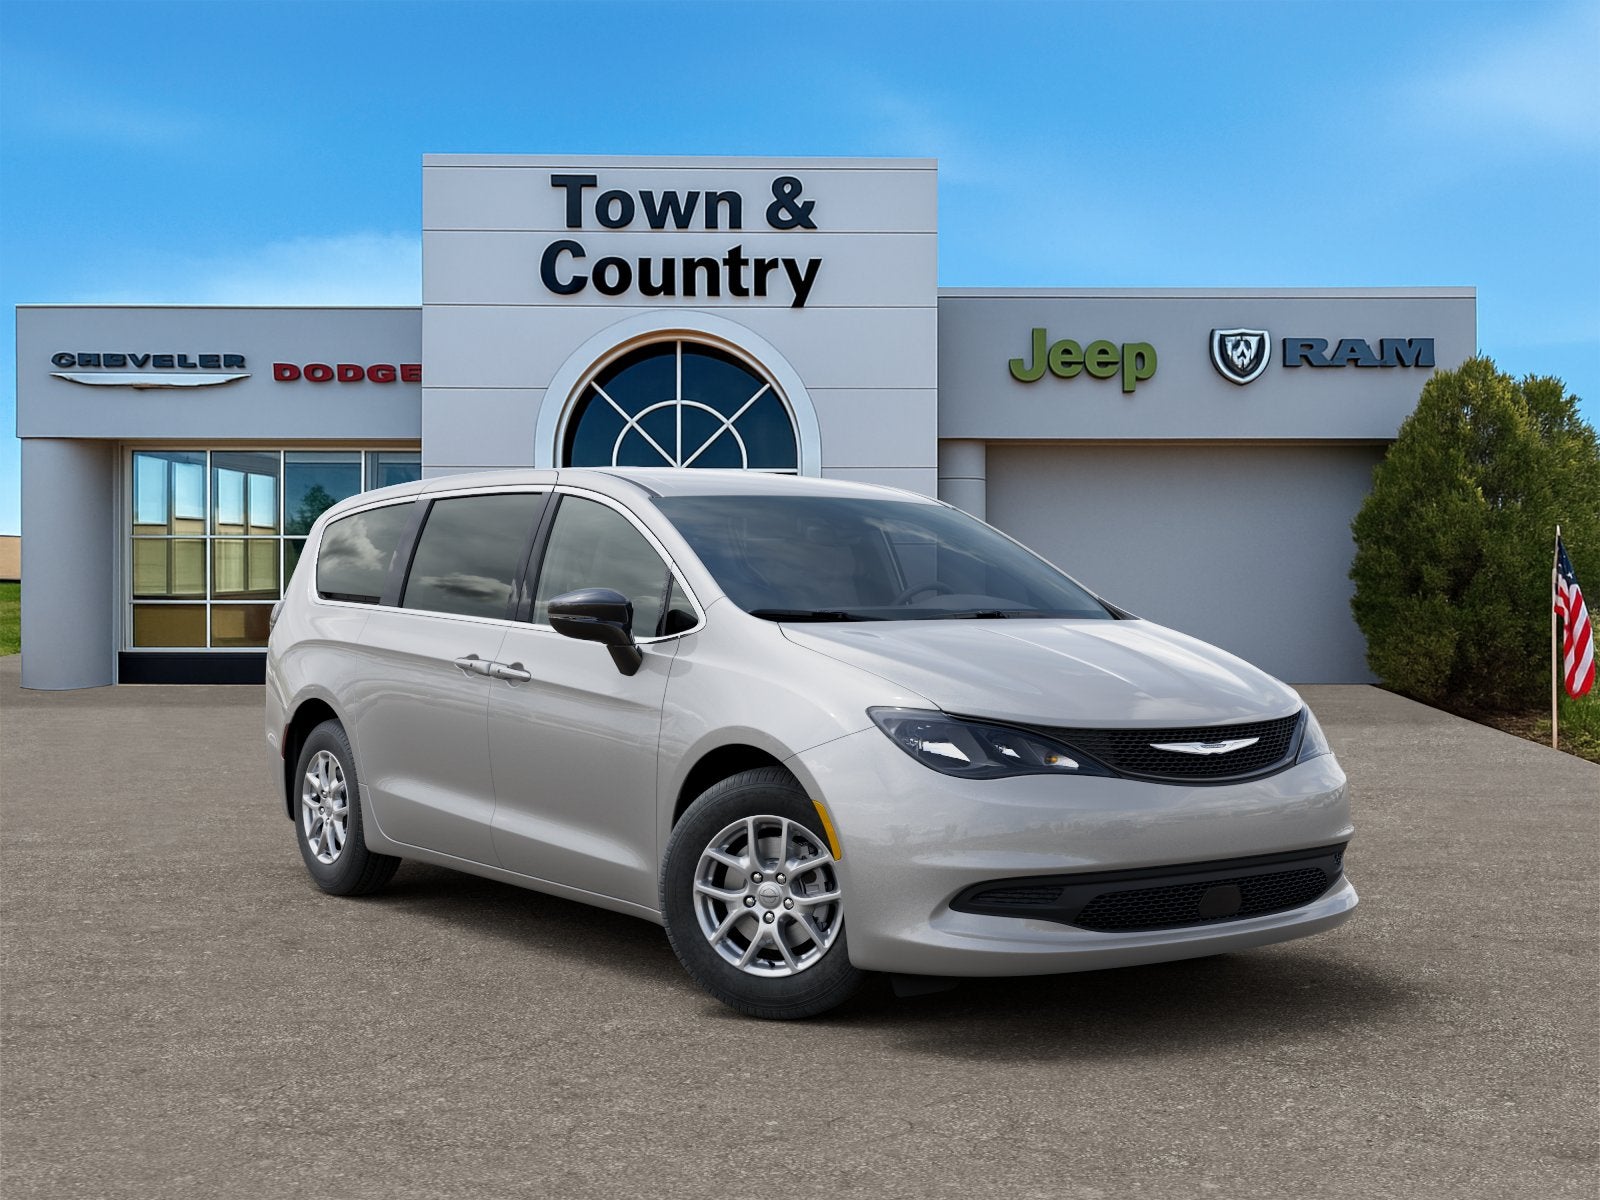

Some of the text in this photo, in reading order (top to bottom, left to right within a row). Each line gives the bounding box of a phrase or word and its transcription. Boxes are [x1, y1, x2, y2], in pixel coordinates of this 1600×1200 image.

[550, 174, 818, 230] Town &
[540, 239, 823, 308] Country
[273, 363, 422, 383] DODGE
[1009, 328, 1157, 392] Jeep
[1283, 337, 1435, 368] RAM
